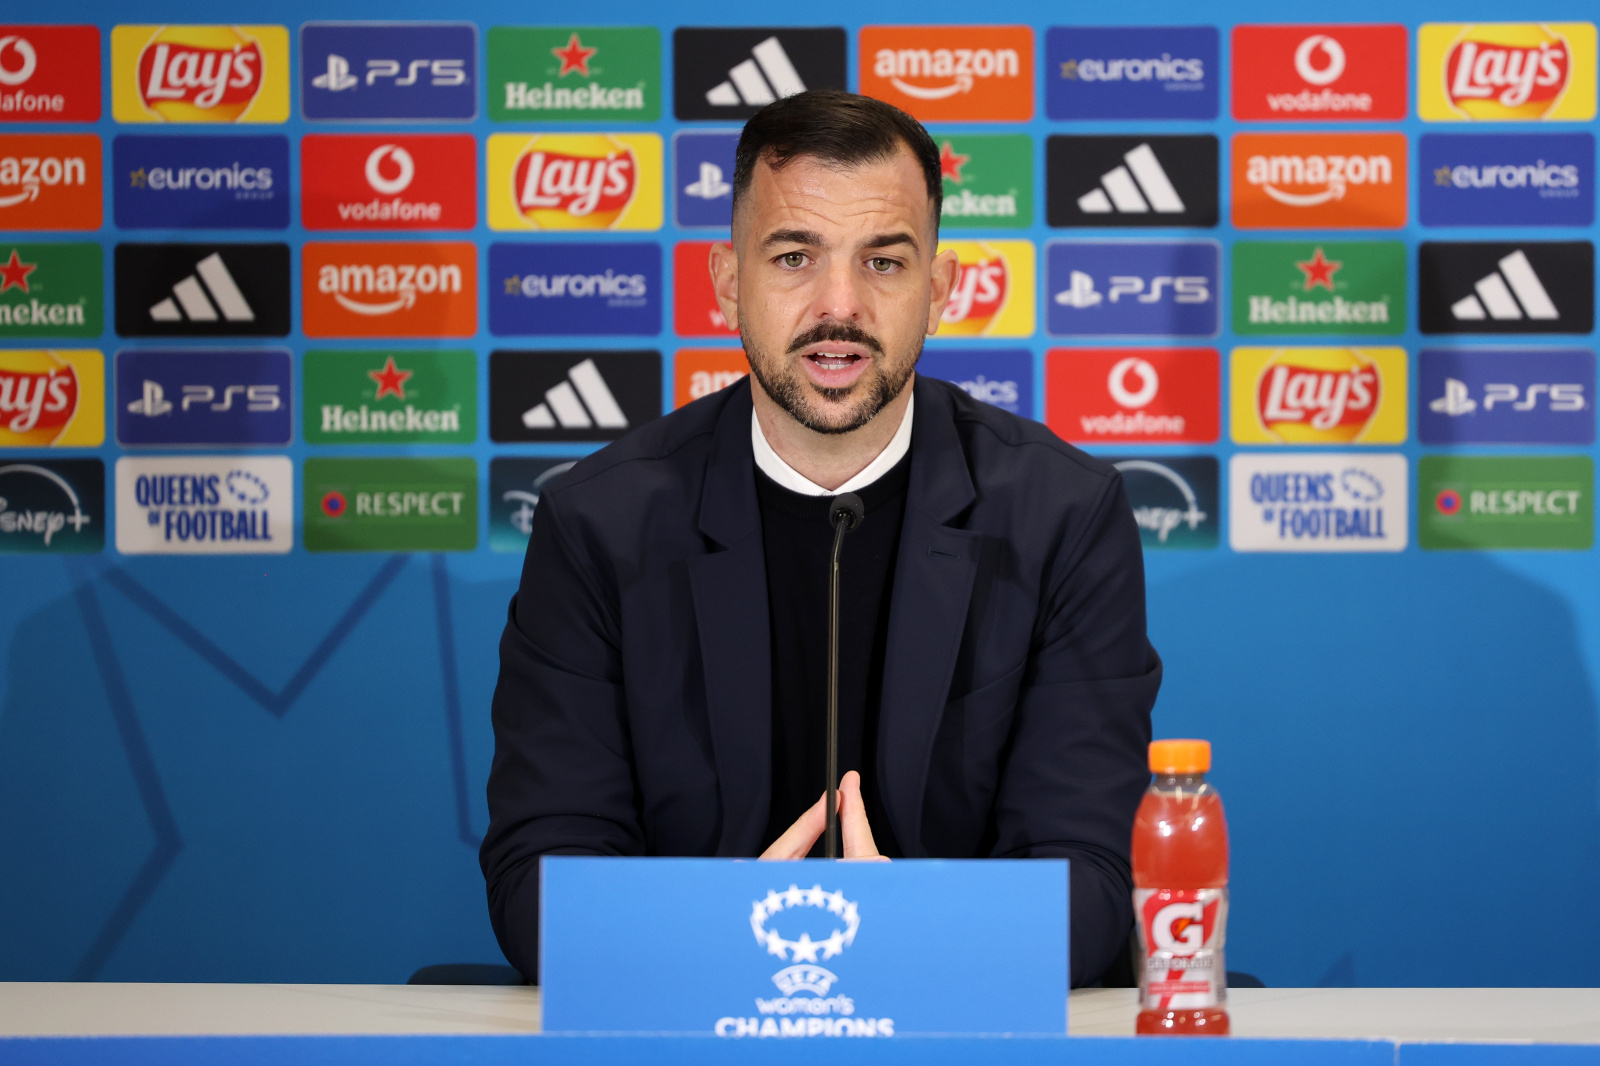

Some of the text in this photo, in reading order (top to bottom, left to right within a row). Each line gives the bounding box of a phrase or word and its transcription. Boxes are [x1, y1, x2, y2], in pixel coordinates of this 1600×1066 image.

[146, 44, 255, 108] Lay's
[366, 59, 466, 86] PS5
[874, 48, 1019, 77] amazon
[1078, 53, 1204, 82] euronics
[1452, 41, 1564, 107] Lay's
[0, 89, 64, 112] afone
[504, 81, 644, 109] Heineken
[1267, 89, 1372, 112] vodafone
[0, 157, 85, 186] azon
[148, 161, 273, 190] euronics
[521, 151, 629, 216] Lay's
[1247, 155, 1391, 184] amazon
[1452, 160, 1578, 189] euronics
[338, 197, 441, 220] vodafone
[941, 188, 1017, 217] eken
[318, 264, 461, 294] amazon
[522, 268, 647, 298] euronics
[1109, 276, 1209, 303] PS5
[0, 298, 84, 325] neken
[1249, 295, 1389, 323] Heineken
[182, 385, 280, 411] PS5
[1265, 365, 1375, 430] Lay's
[1483, 384, 1584, 411] PS5
[321, 404, 459, 432] Heineken
[1080, 411, 1185, 435] vodafone
[136, 476, 219, 508] QUEENS
[1250, 472, 1335, 504] QUEENS
[1470, 490, 1580, 515] RESPECT
[355, 492, 464, 516] RESPECT
[165, 510, 271, 542] FOOTBALL
[1279, 506, 1387, 539] FOOTBALL
[1152, 901, 1205, 957] G
[714, 1016, 895, 1038] CHAMPIONS
